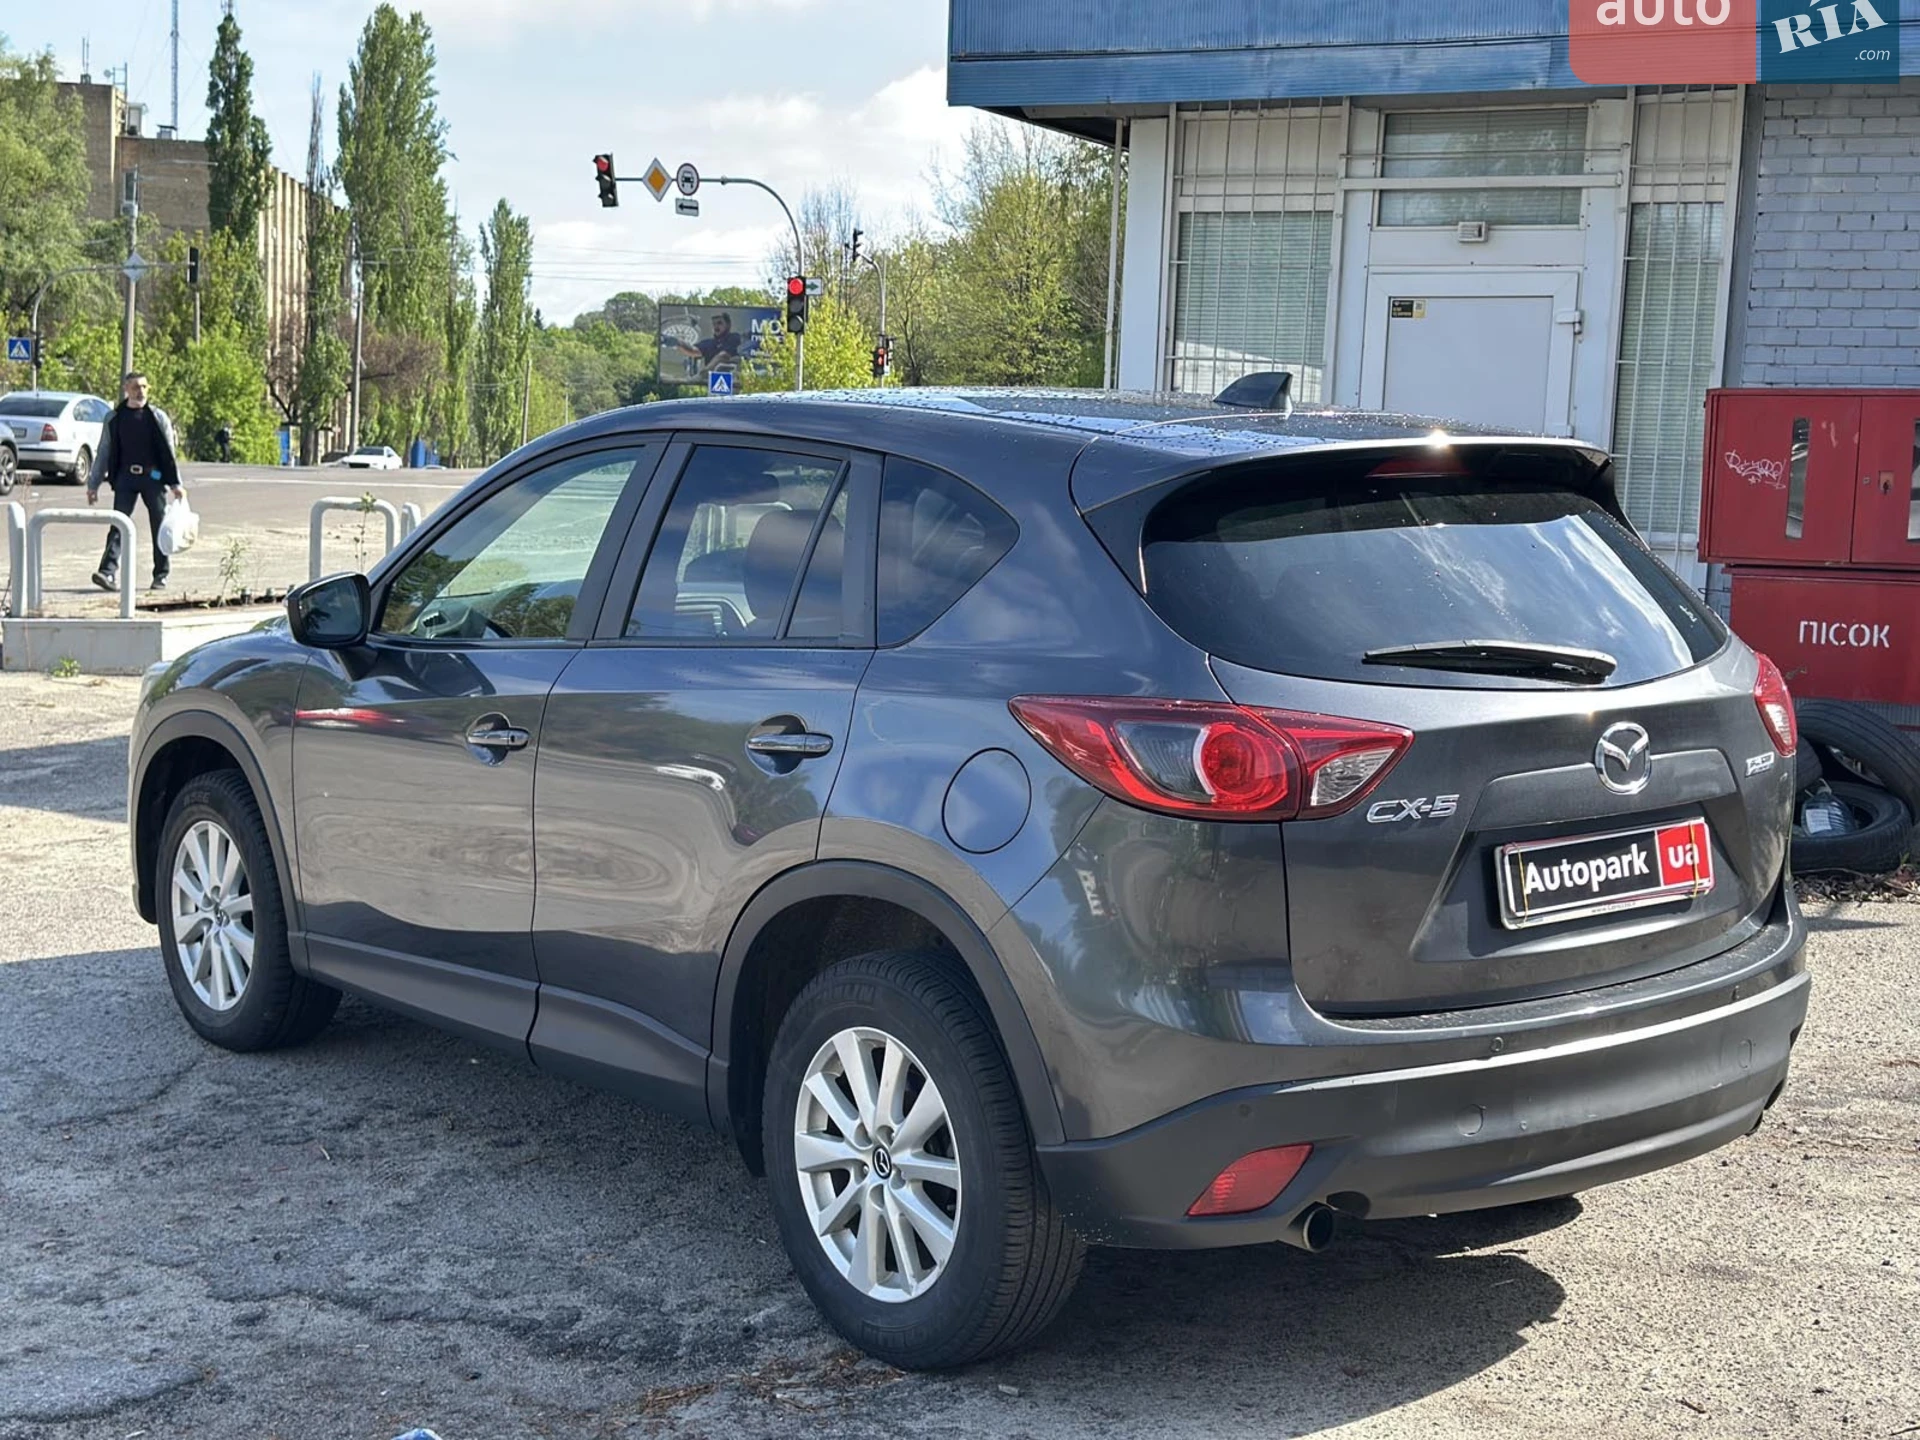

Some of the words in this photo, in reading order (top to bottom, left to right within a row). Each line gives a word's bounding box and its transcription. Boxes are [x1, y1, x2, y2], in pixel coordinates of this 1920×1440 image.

[1799, 620, 1890, 649] ПІСОК
[1366, 794, 1460, 824] CX-5
[1525, 843, 1650, 895] Autopark
[1667, 843, 1700, 869] ua
